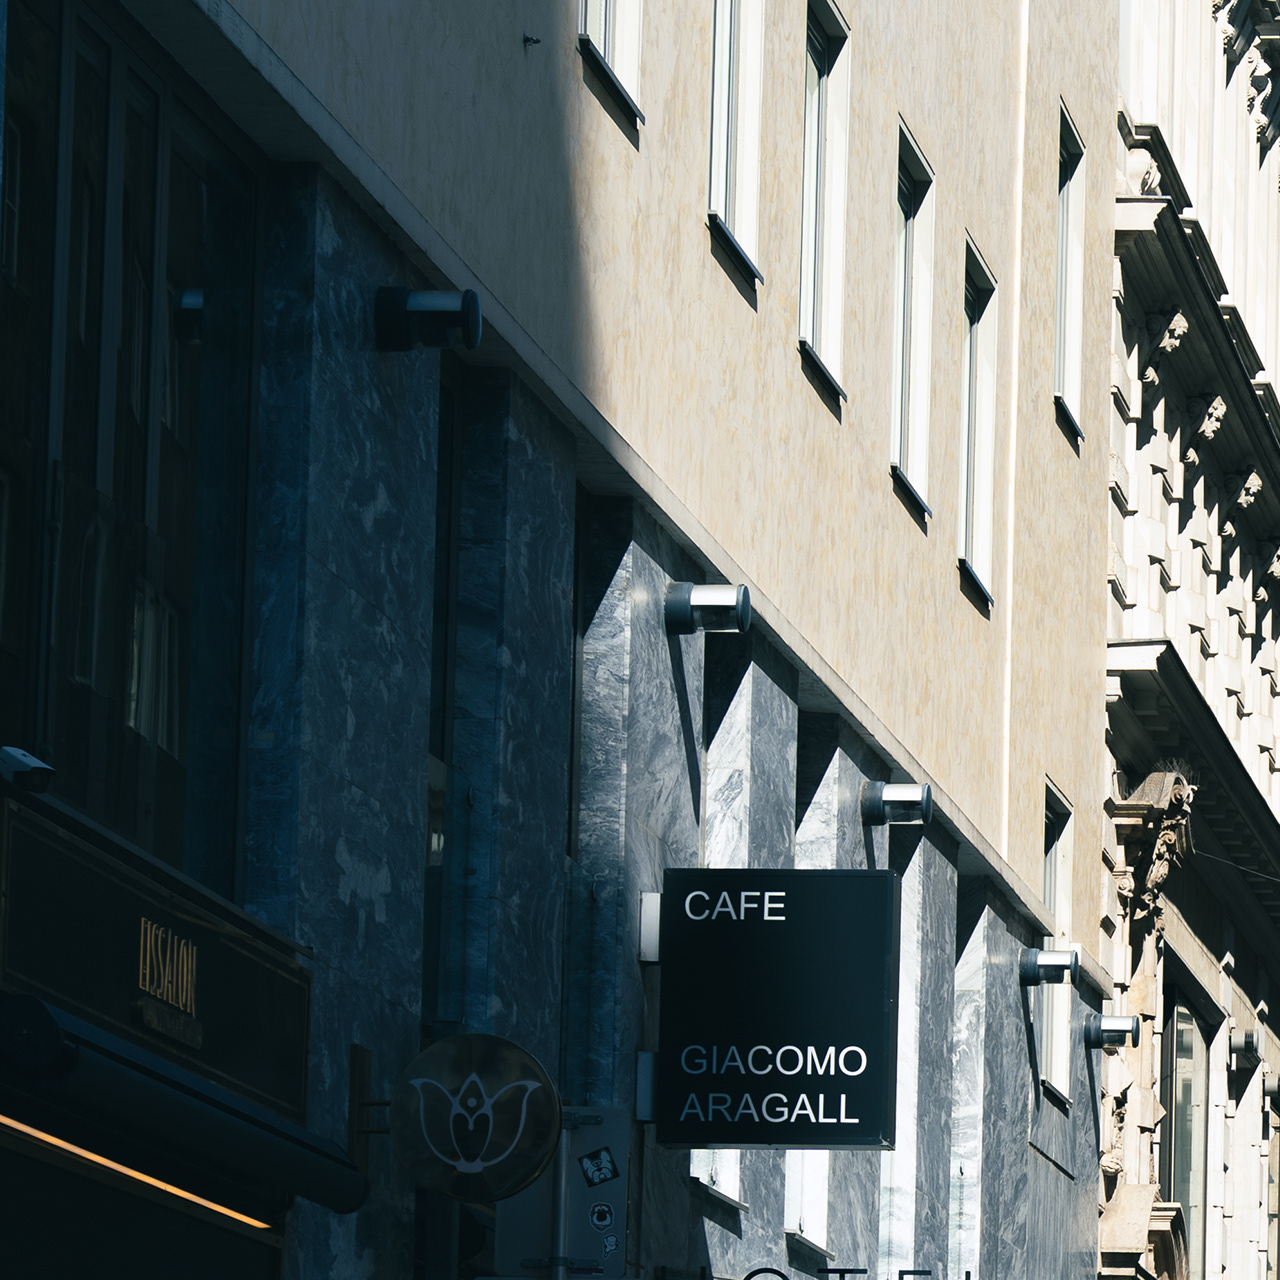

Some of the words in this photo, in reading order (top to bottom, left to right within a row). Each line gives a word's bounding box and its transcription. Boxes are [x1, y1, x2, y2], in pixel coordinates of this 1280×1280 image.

[683, 890, 787, 923] CAFE
[138, 916, 198, 1020] EISSALON
[678, 1044, 869, 1077] GIACOMO
[678, 1092, 860, 1124] ARAGALL
